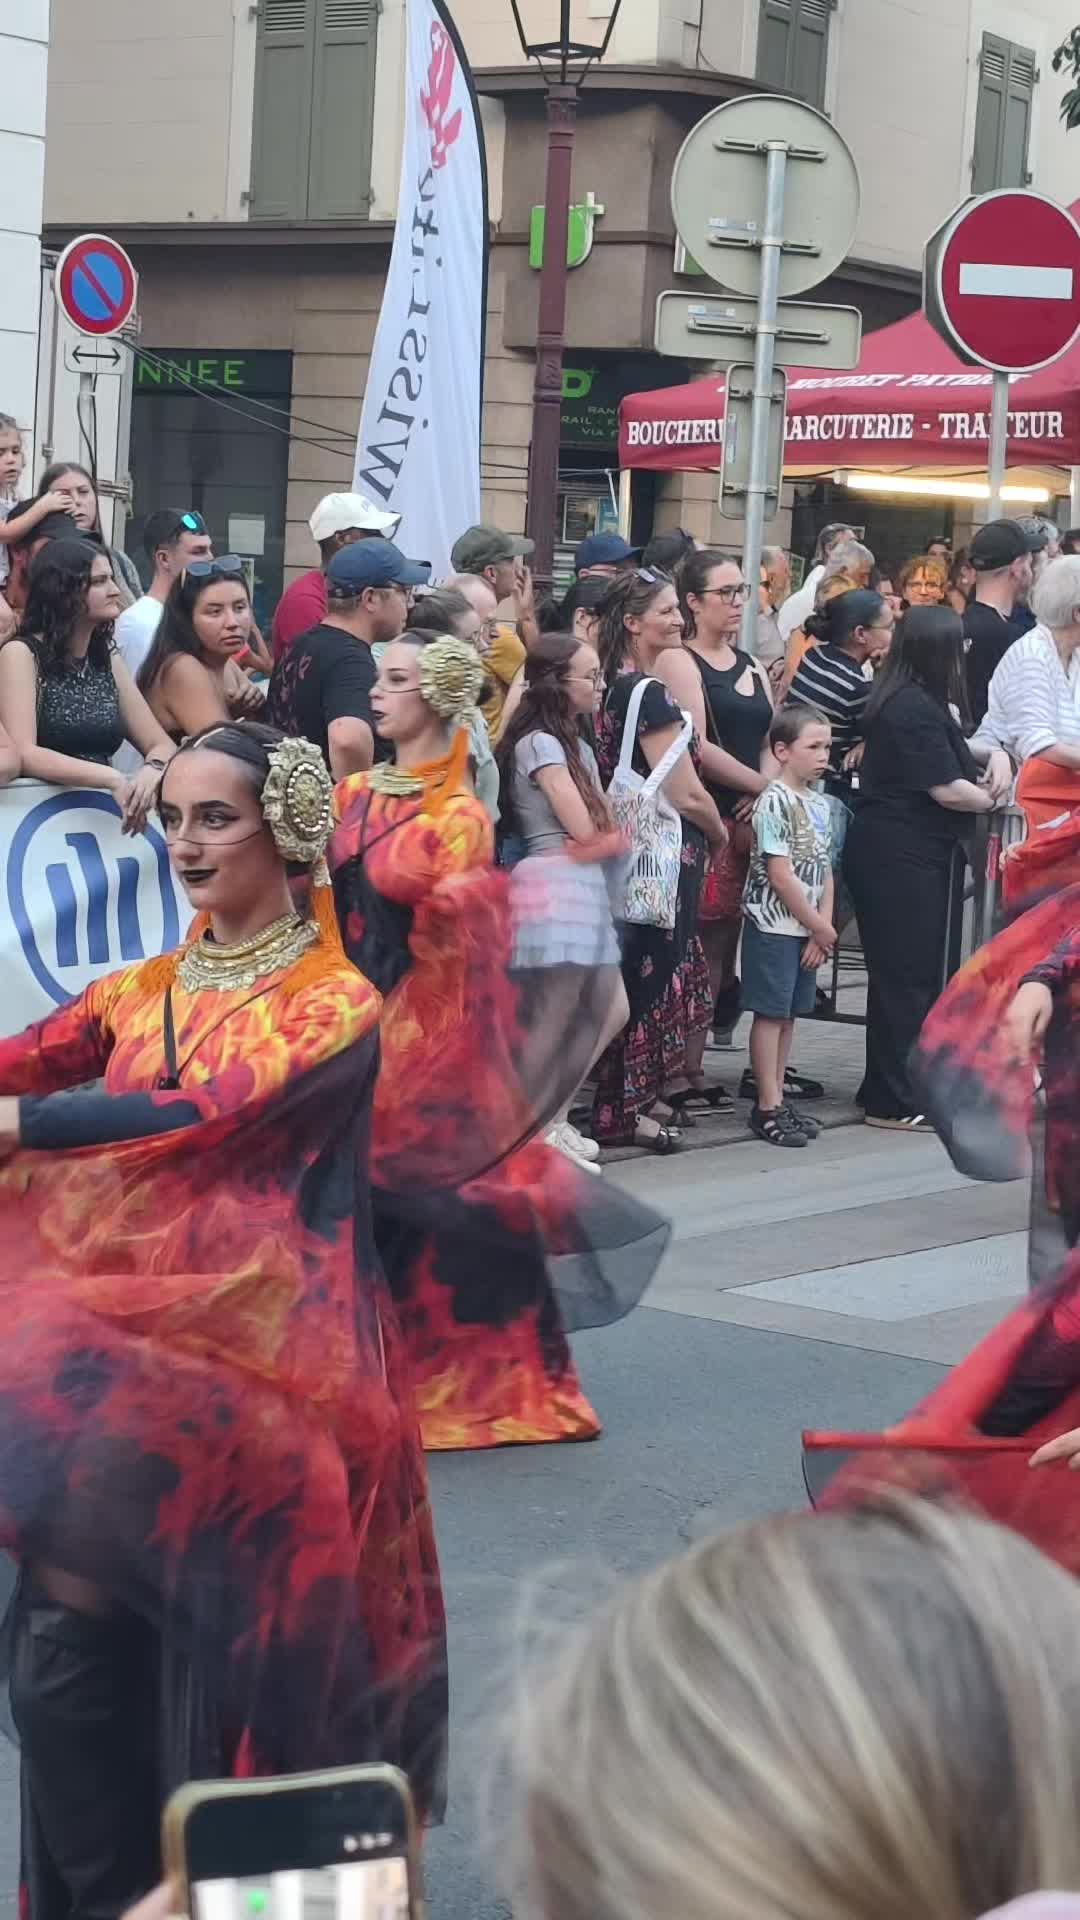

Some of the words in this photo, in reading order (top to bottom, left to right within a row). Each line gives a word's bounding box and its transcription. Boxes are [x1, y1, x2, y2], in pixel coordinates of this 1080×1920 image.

[138, 360, 245, 385] NNEE
[626, 418, 724, 445] BOUCHERI
[784, 413, 914, 441] ARCUTERIE
[938, 411, 1064, 439] TRATEUR
